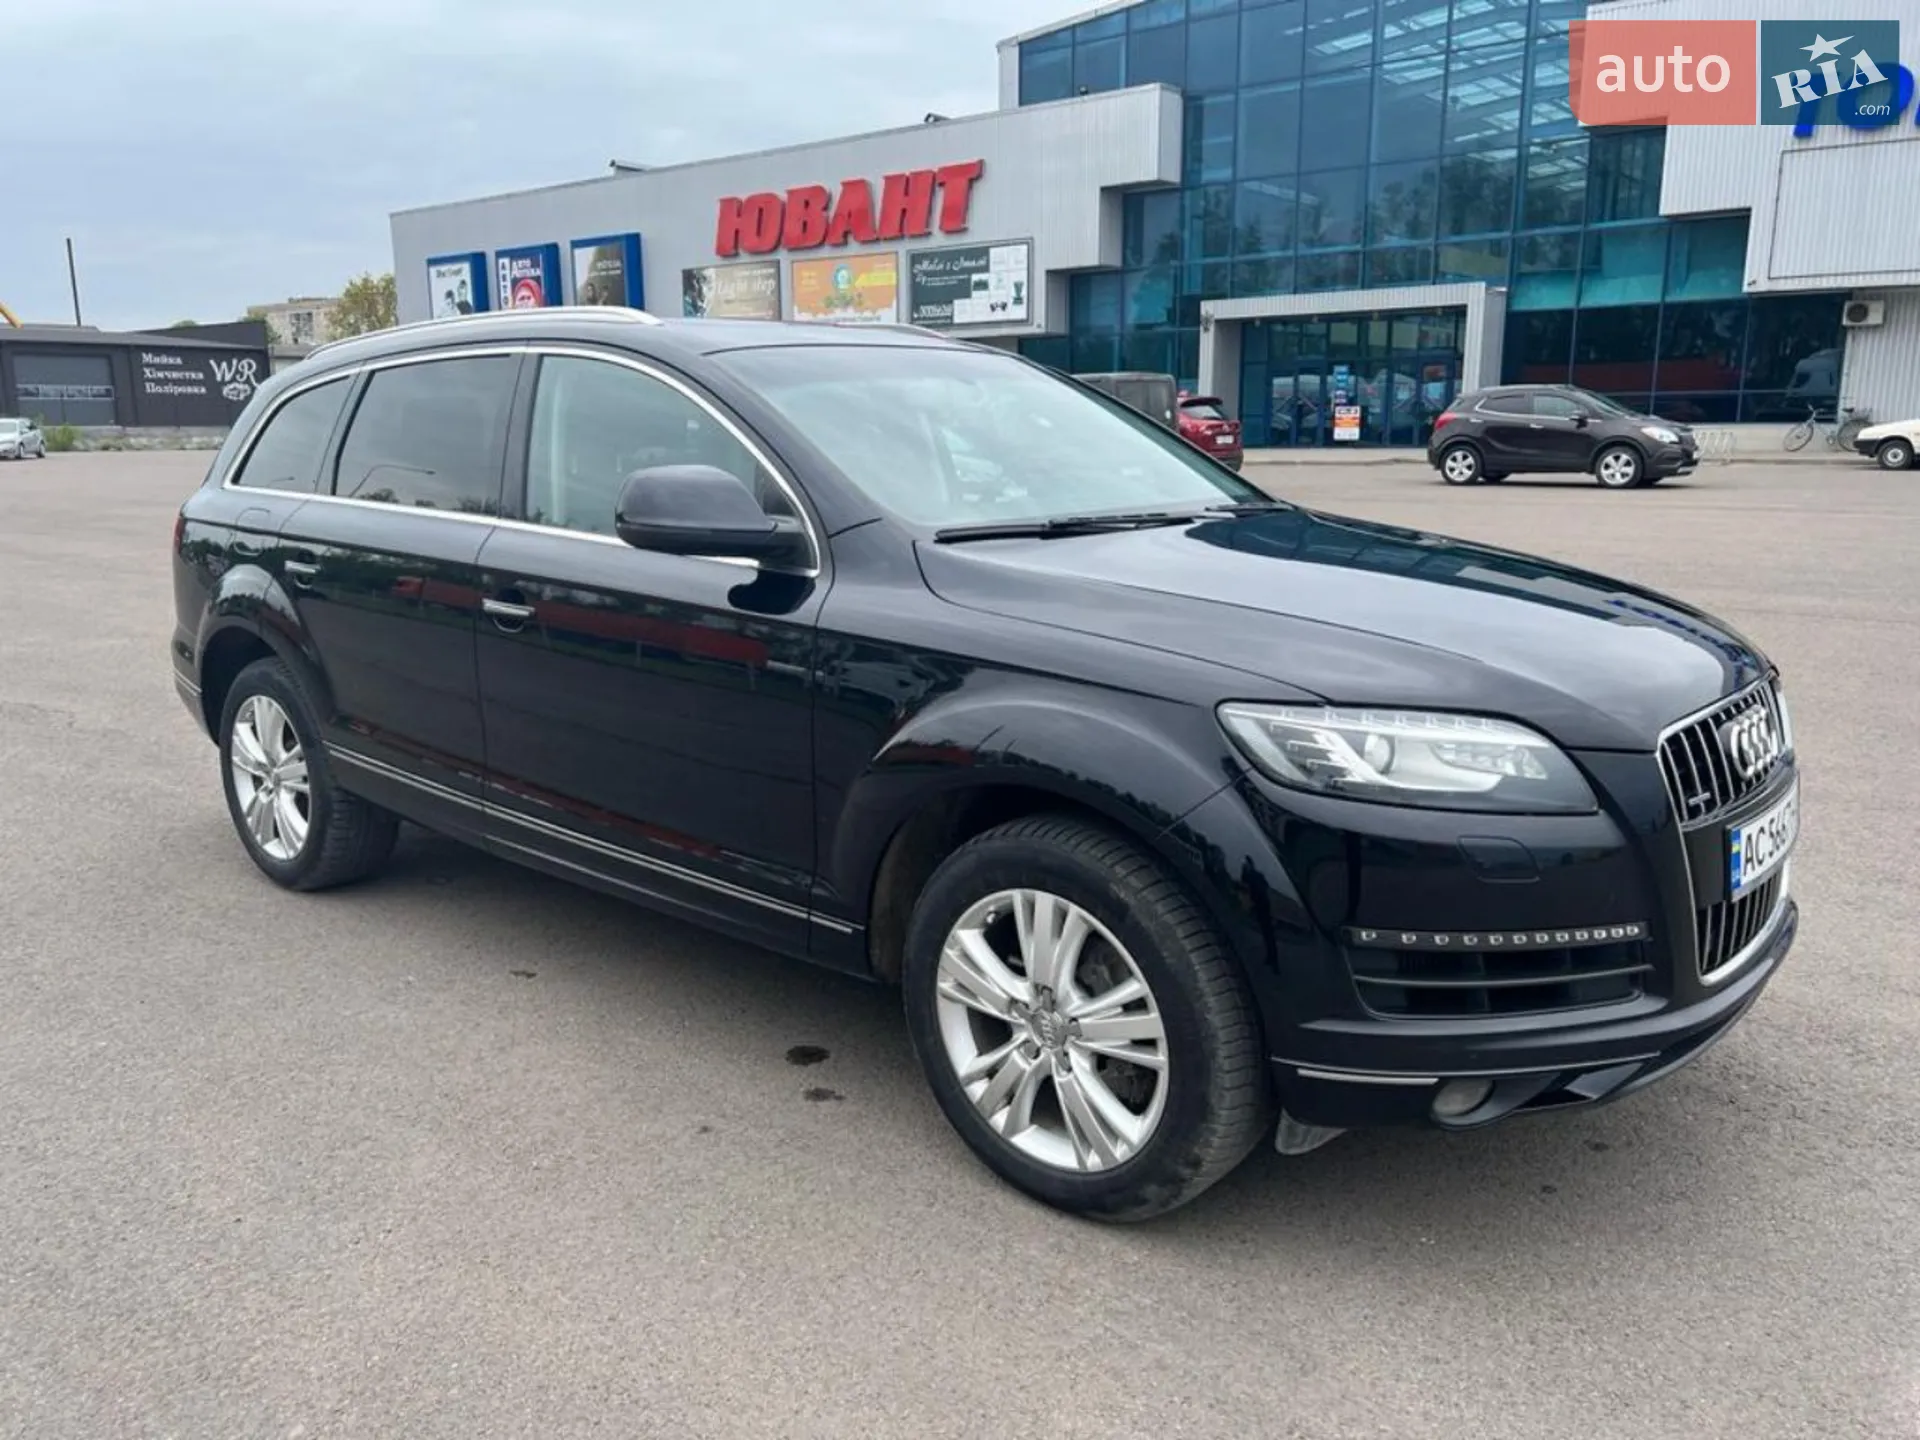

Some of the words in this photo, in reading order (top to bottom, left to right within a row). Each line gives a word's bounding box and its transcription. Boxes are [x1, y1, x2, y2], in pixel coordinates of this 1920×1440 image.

[715, 158, 985, 258] ЮВАНТ
[141, 352, 182, 365] Мийка
[143, 367, 204, 380] Хімчистка
[144, 381, 206, 396] Поліровка
